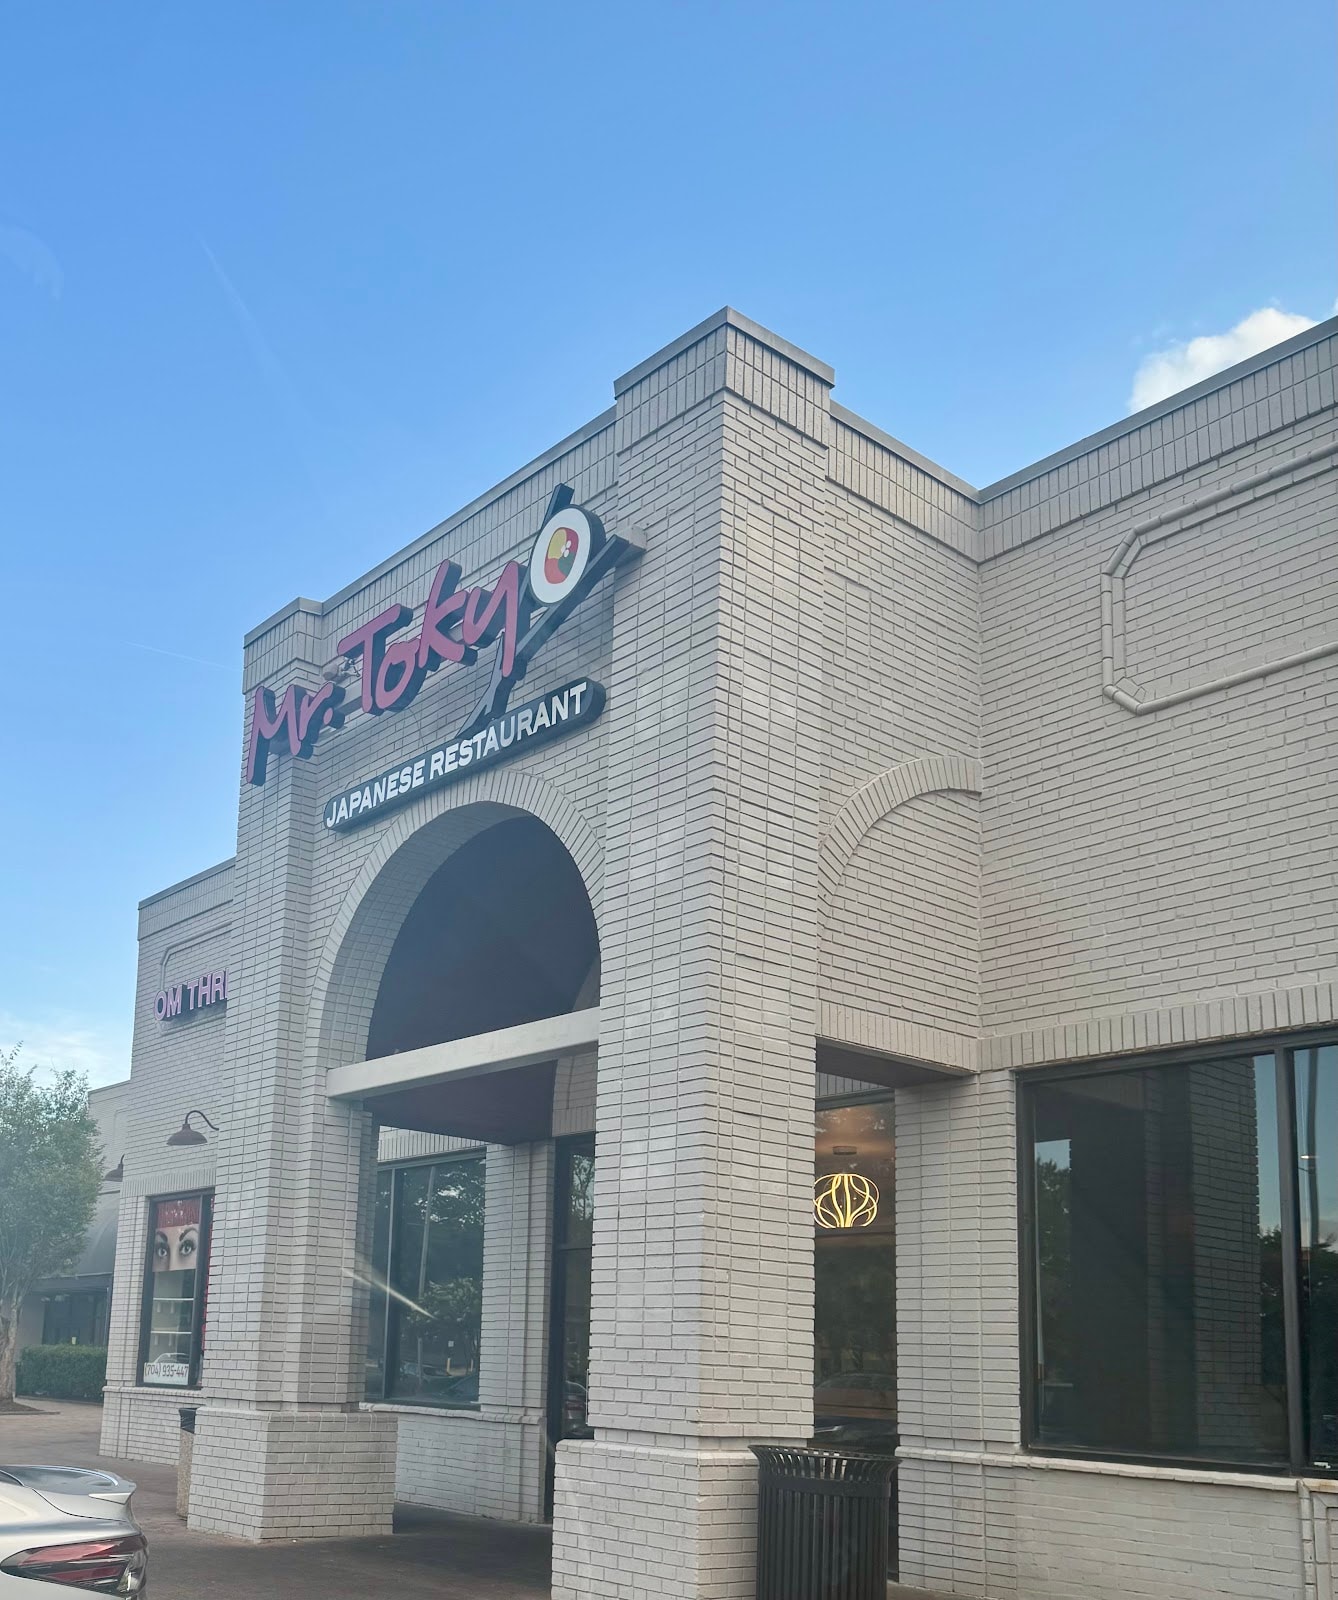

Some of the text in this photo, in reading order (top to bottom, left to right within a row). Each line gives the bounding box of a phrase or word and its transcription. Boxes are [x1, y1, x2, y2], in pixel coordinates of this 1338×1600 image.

[246, 683, 344, 786] Mr.
[326, 681, 588, 828] JAPANESE RESTAURANT
[154, 984, 183, 1021] OM
